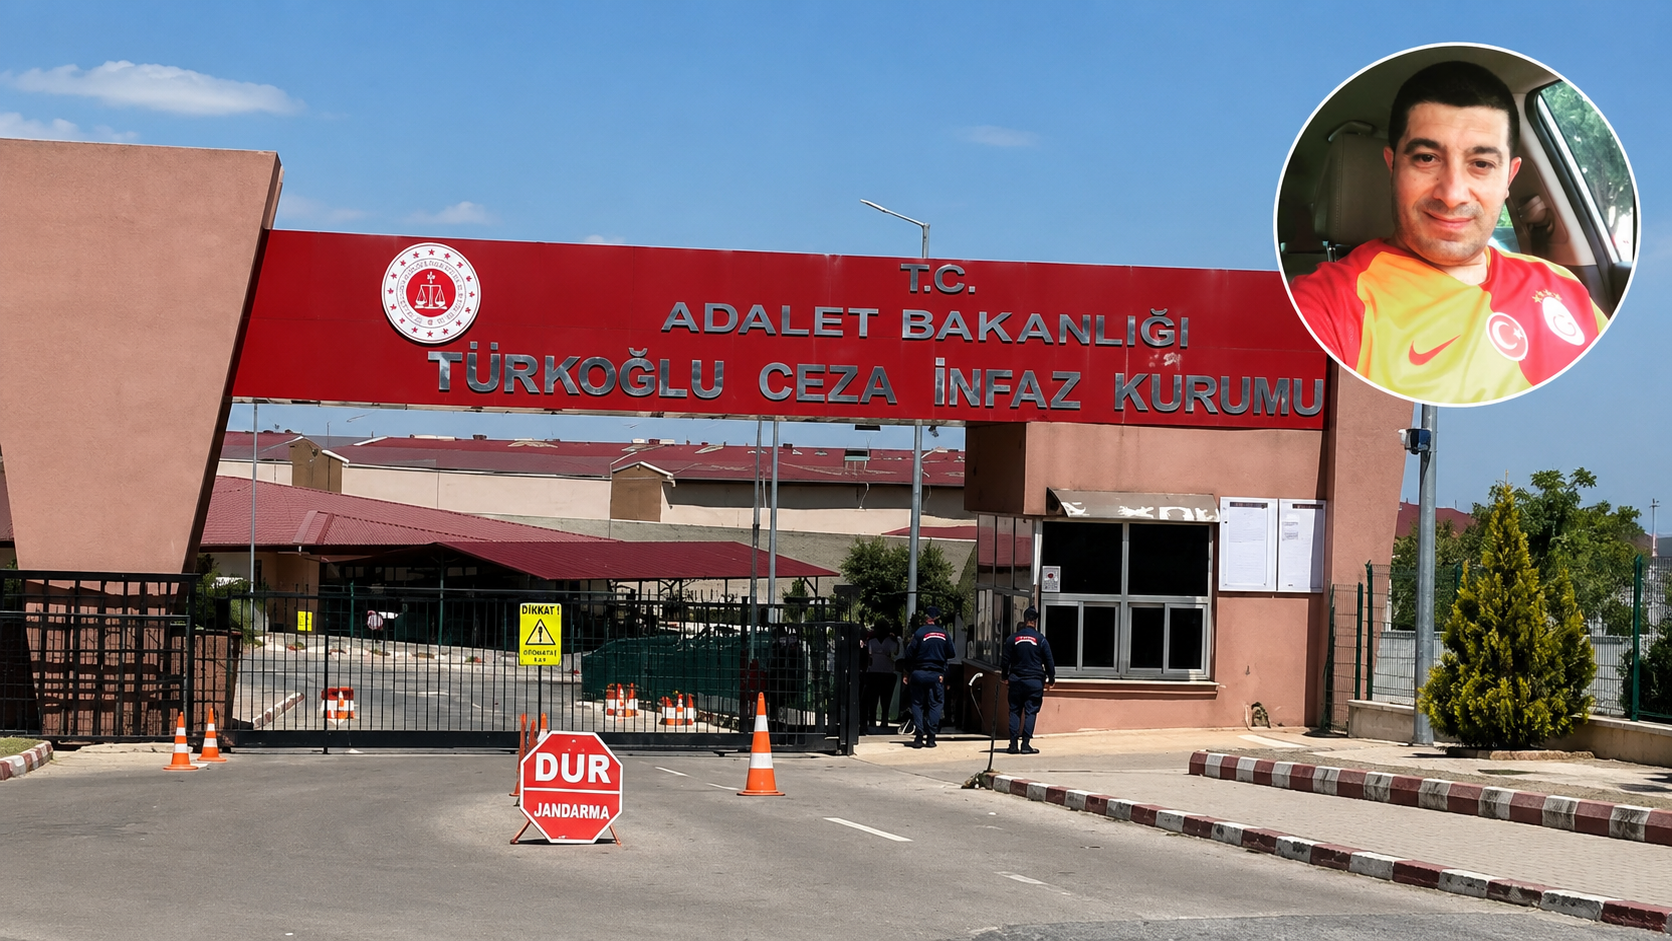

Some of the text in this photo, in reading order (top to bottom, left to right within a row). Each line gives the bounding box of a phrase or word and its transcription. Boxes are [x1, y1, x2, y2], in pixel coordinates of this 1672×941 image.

[900, 263, 976, 293] T.C.
[661, 301, 1189, 347] ADALET BAKANLIĞI
[428, 341, 1324, 416] TÜRKOĞLU CEZA İNFAZ KURUMU
[535, 752, 611, 784] DUR
[534, 803, 610, 820] JANDARMA
